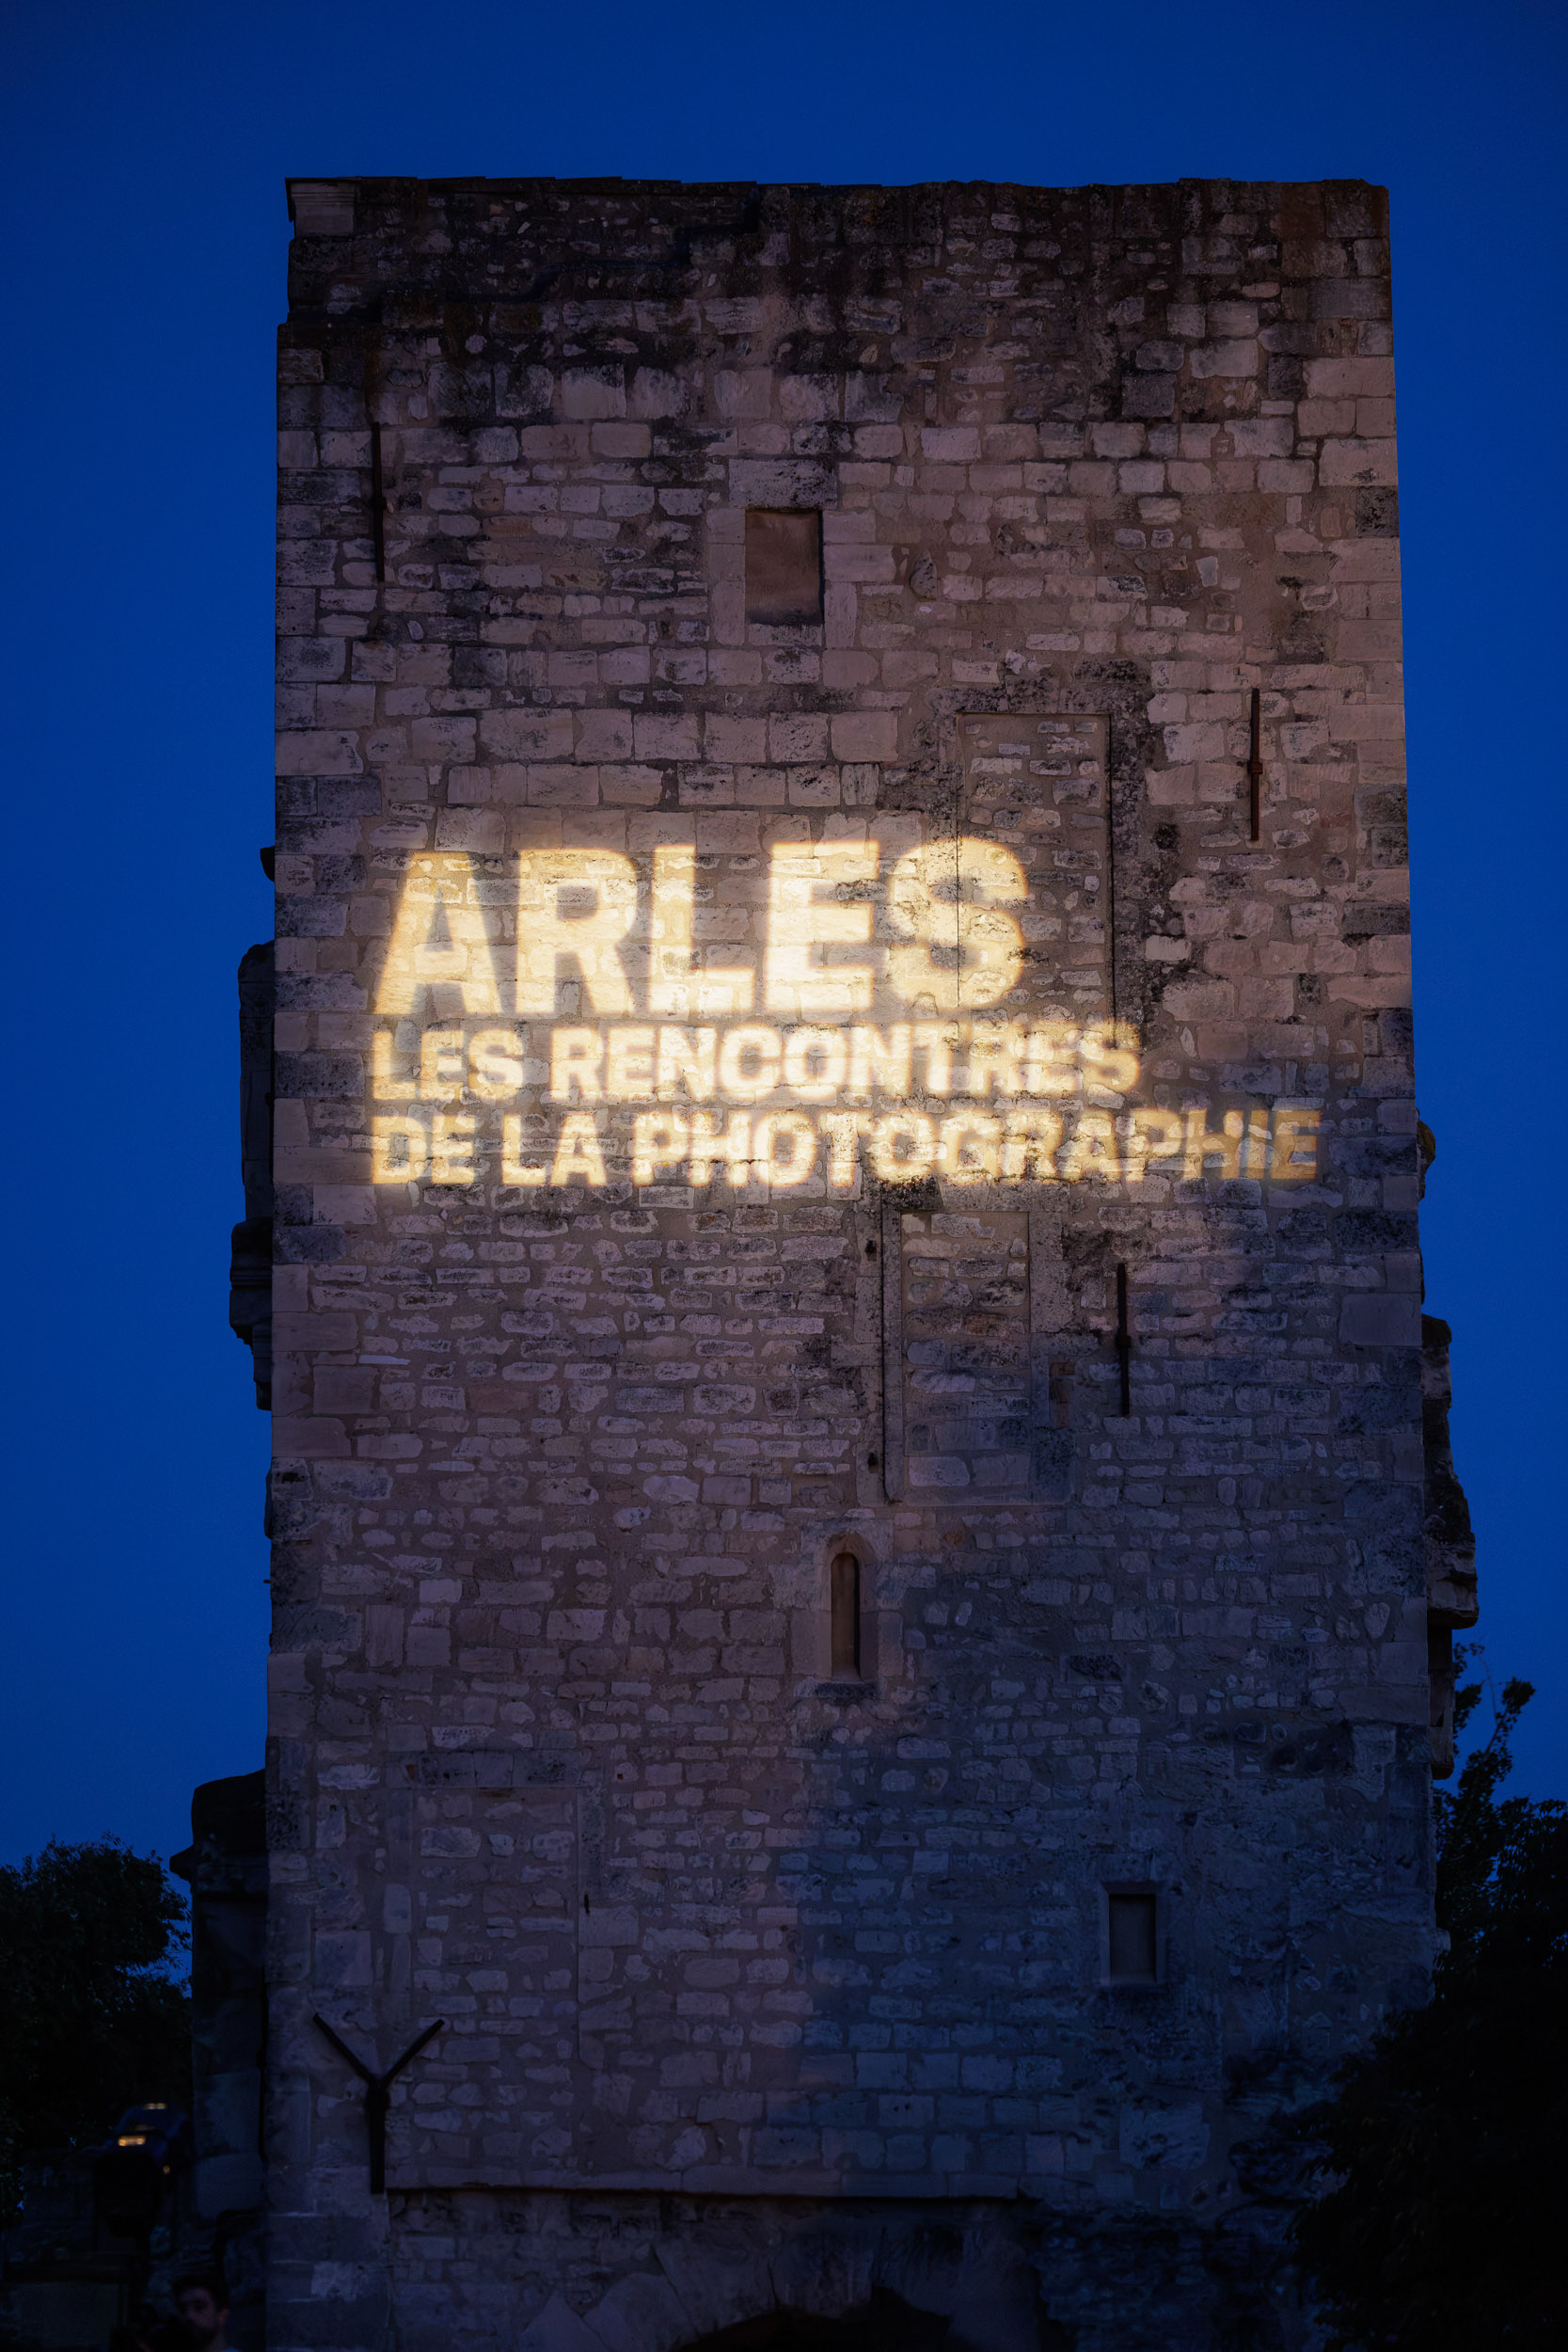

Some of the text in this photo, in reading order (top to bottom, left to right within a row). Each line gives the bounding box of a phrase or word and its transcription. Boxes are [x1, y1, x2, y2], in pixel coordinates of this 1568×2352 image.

[372, 836, 1028, 1015] ARLES
[372, 1020, 1142, 1102] LES RENCONTRES
[372, 1107, 1321, 1187] DE LA PHOTOGRAPHIE
